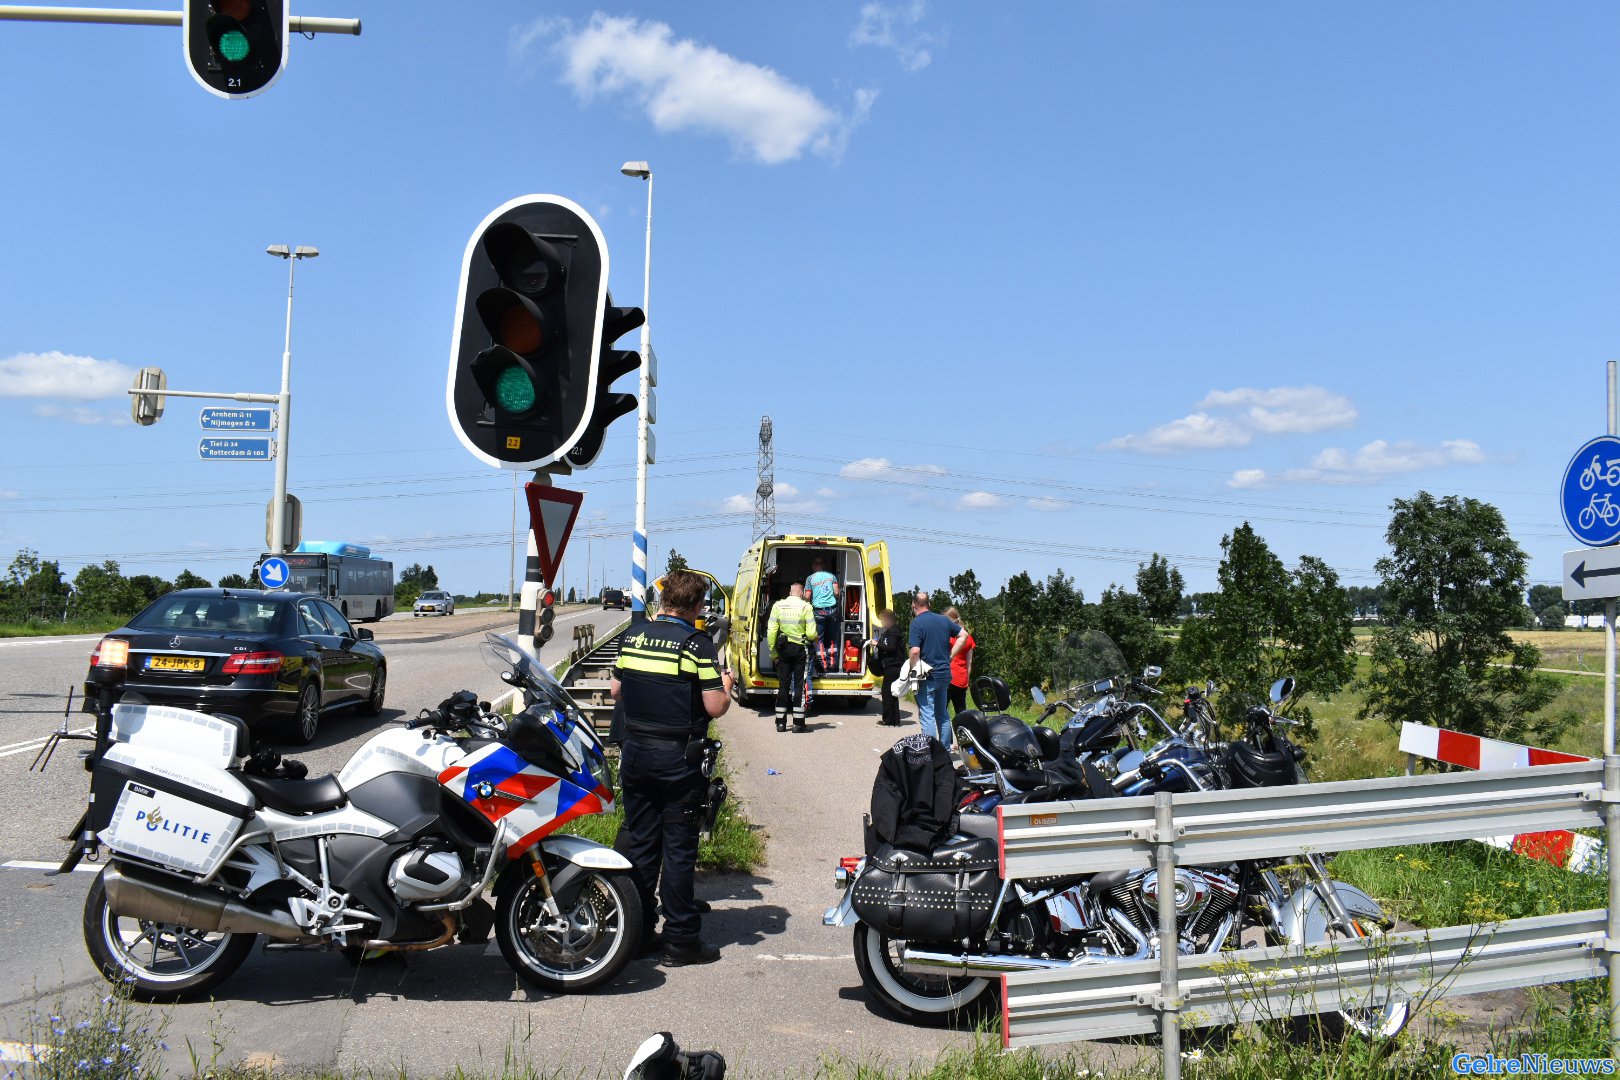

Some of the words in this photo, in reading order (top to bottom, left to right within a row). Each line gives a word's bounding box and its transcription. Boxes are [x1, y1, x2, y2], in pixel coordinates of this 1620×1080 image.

[228, 78, 241, 87] 2.1
[210, 419, 244, 428] Nijmegen
[508, 438, 518, 447] 2.2
[571, 446, 583, 456] 22.1
[629, 634, 673, 649] POLITIE
[154, 657, 200, 669] 24-JPK-8
[133, 785, 149, 795] BMW
[136, 808, 211, 844] POLITIE
